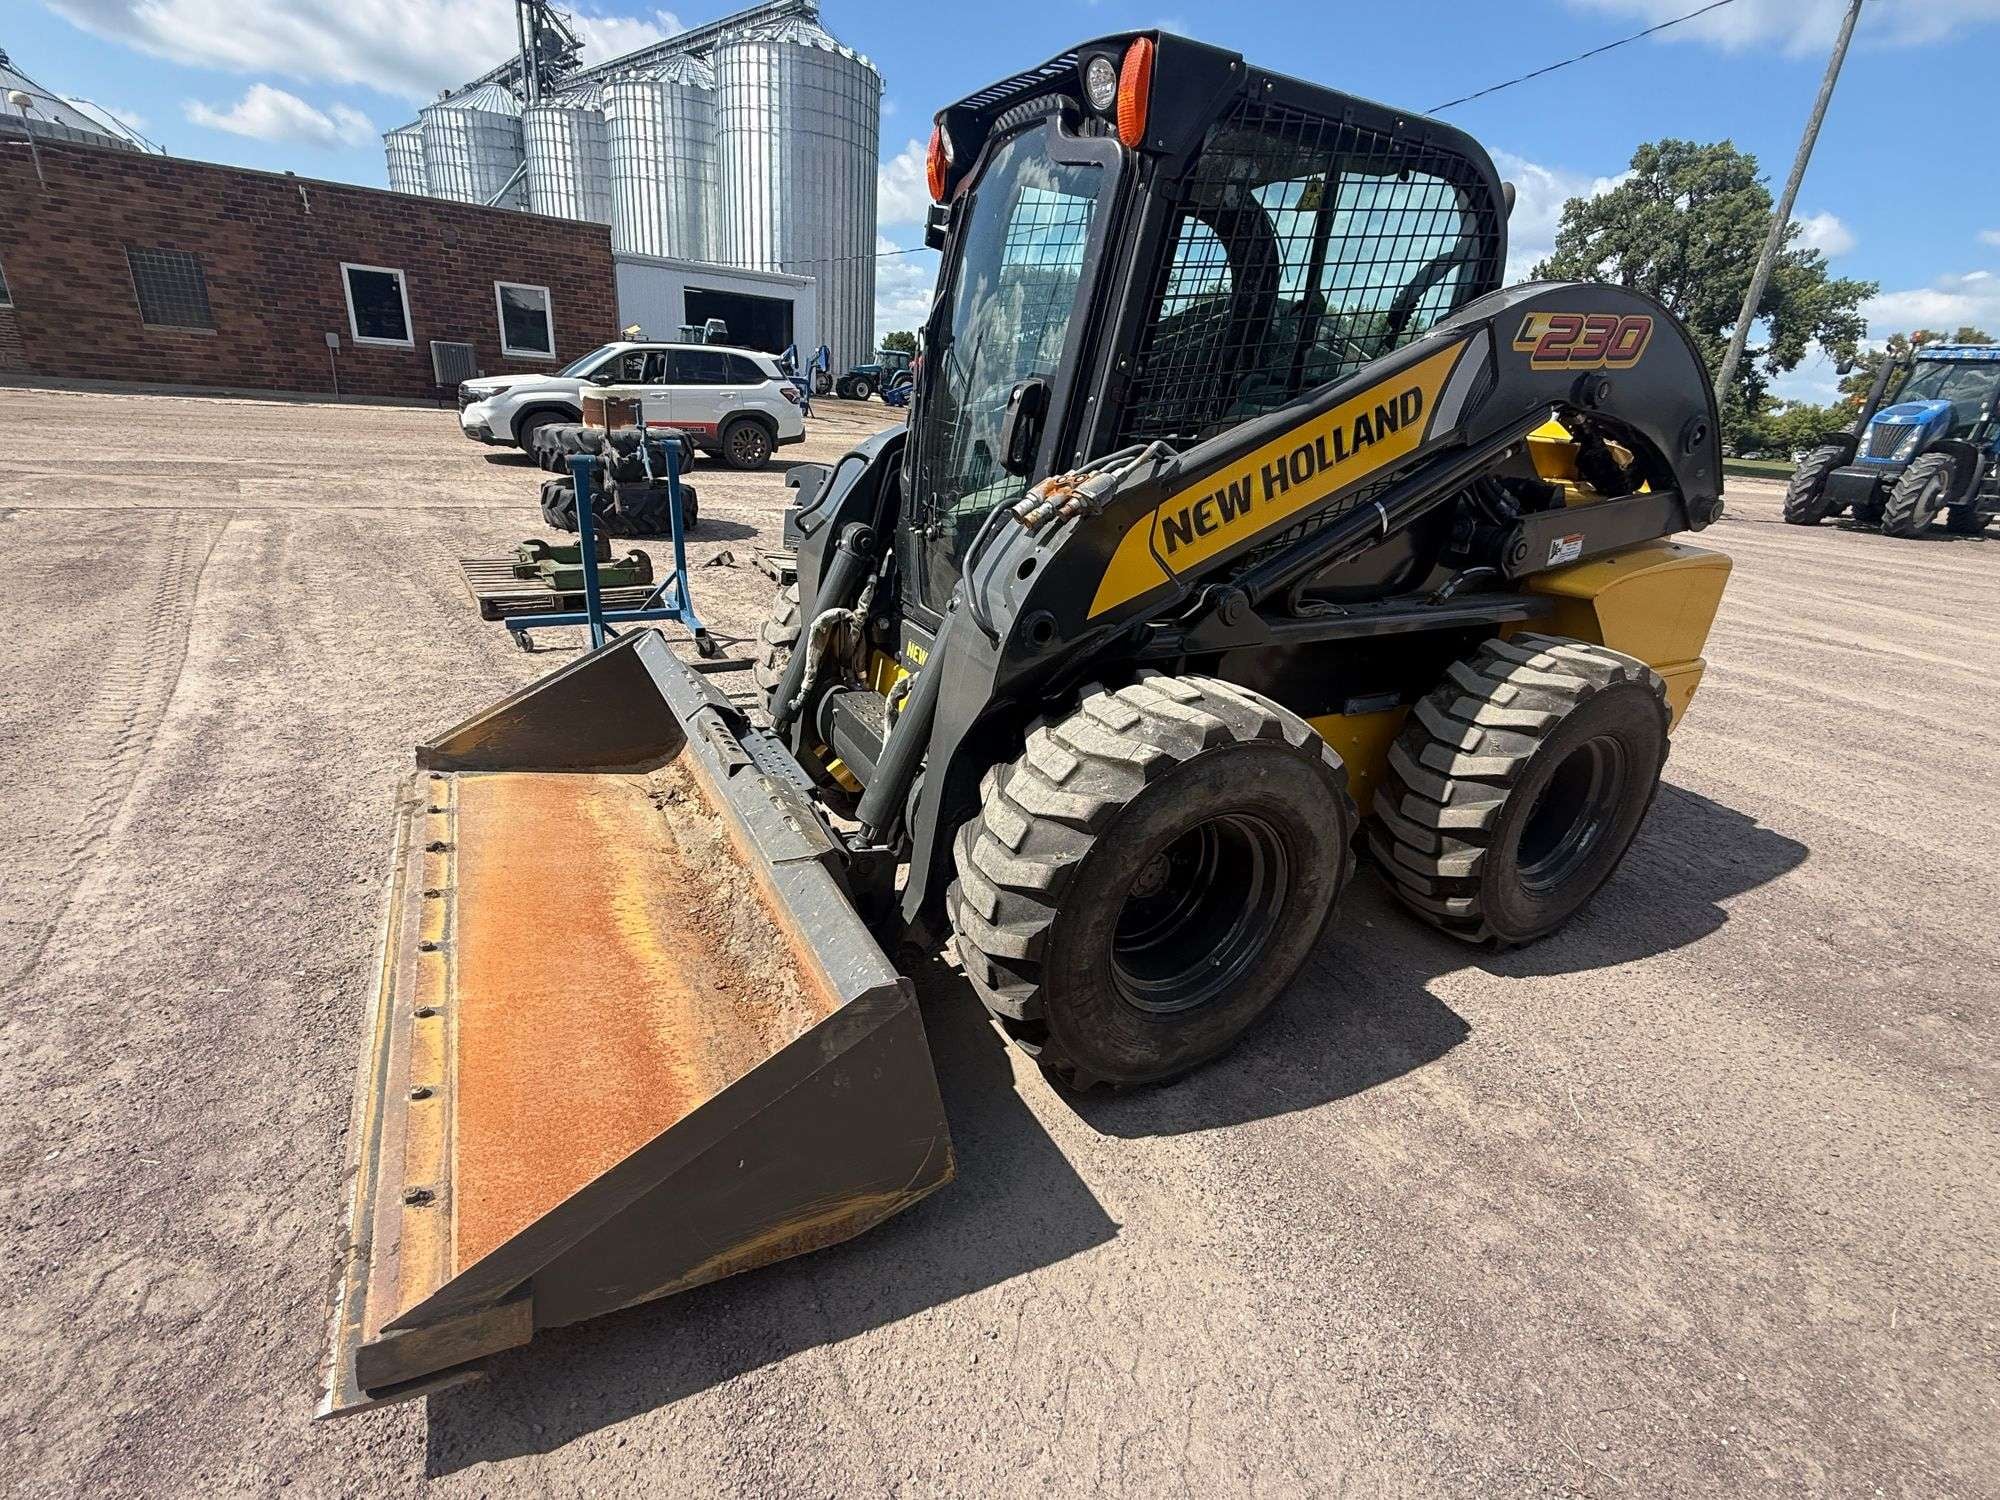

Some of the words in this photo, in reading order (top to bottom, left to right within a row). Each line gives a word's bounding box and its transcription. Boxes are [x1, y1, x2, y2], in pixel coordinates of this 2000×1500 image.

[1514, 313, 1653, 369] L230
[1161, 474, 1251, 554] NEW
[1261, 386, 1423, 502] HOLLAND
[906, 640, 929, 667] NEW
